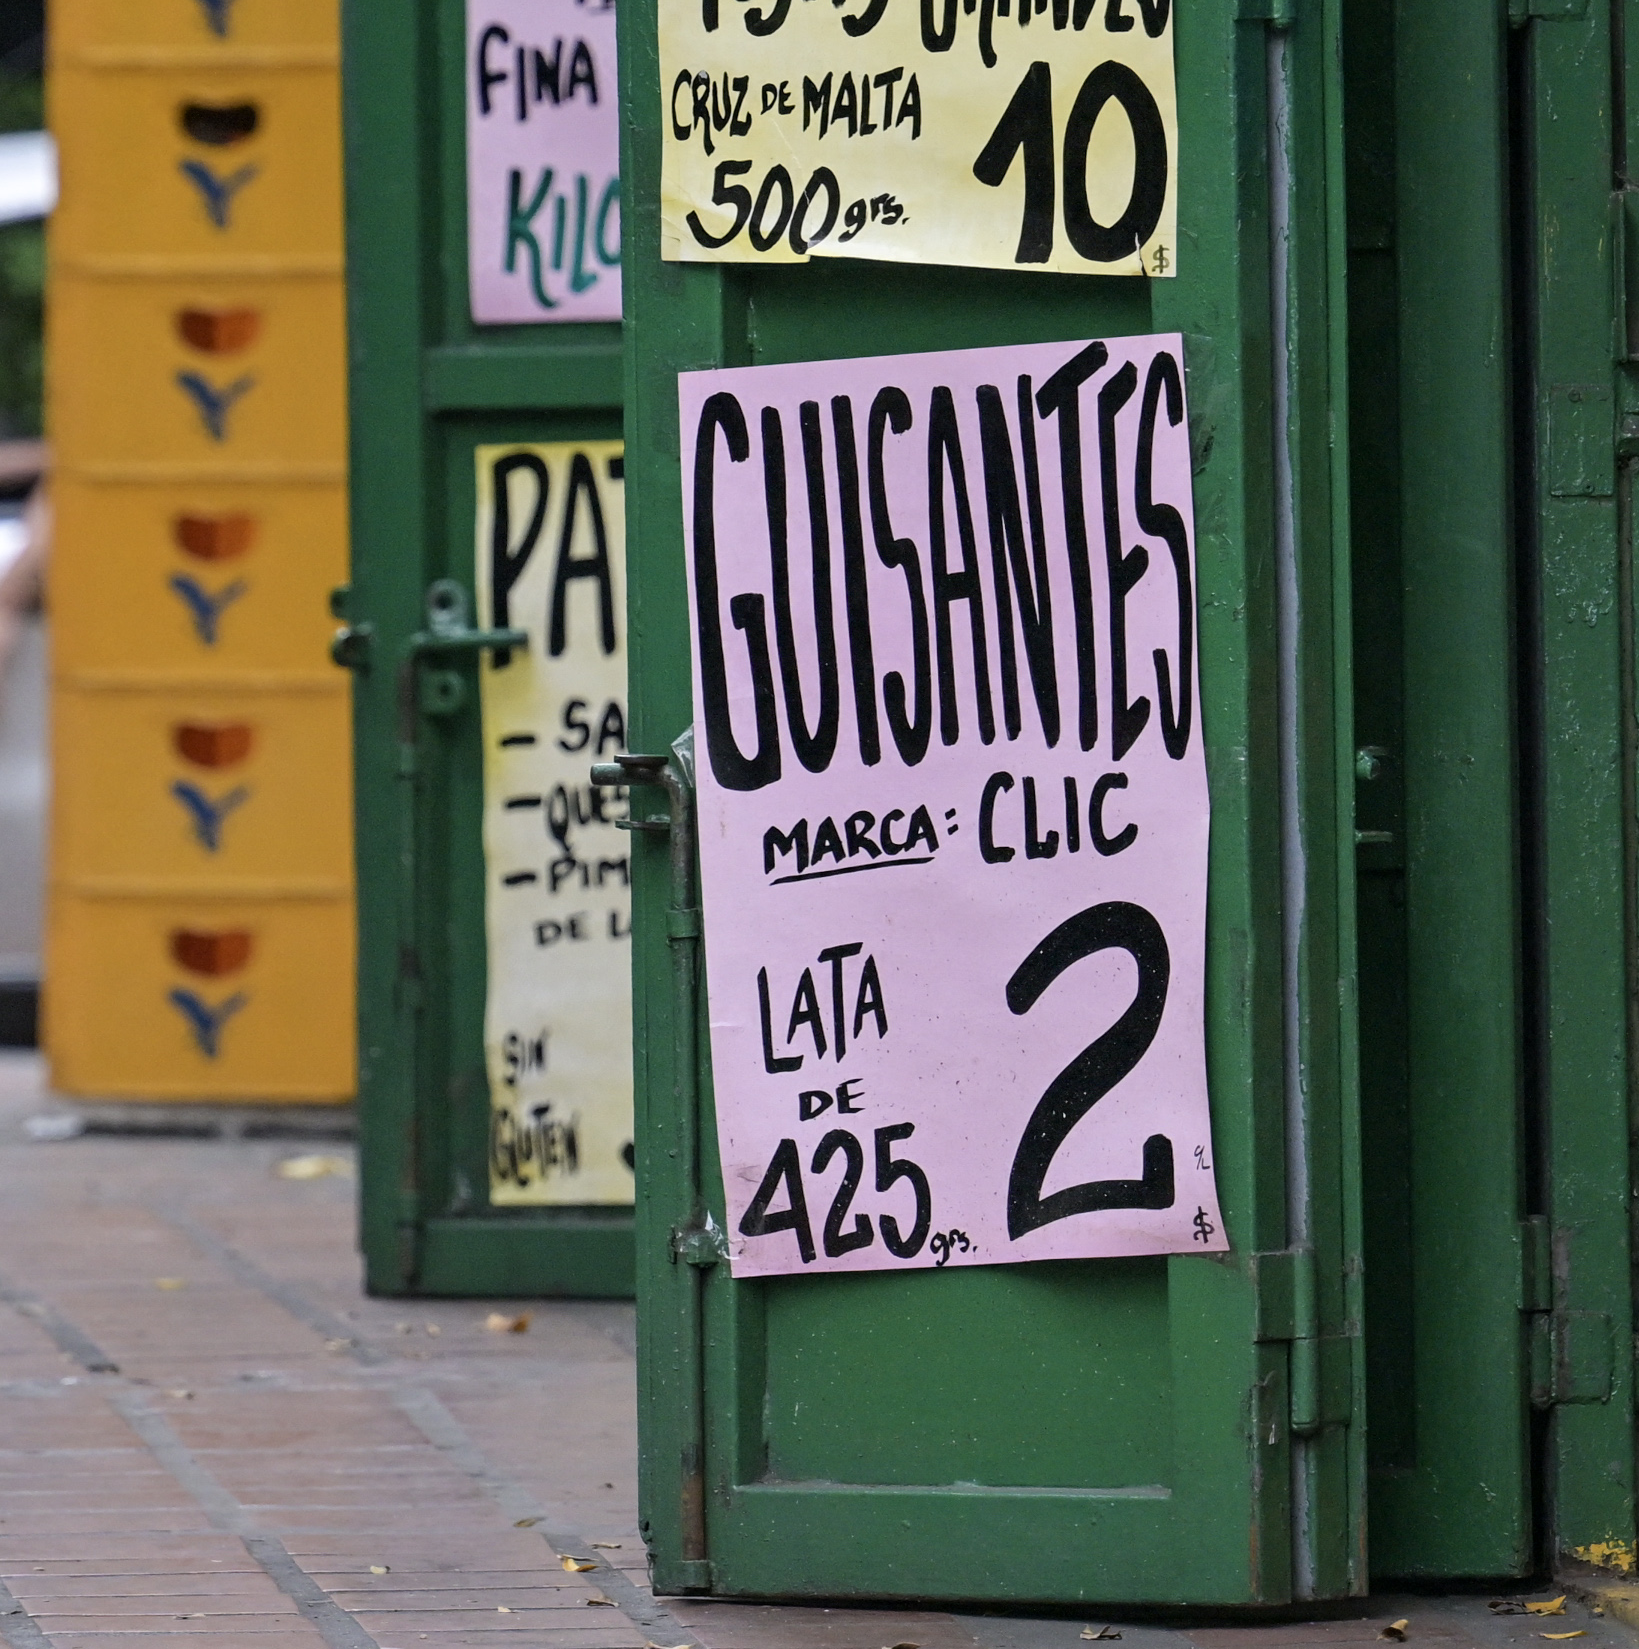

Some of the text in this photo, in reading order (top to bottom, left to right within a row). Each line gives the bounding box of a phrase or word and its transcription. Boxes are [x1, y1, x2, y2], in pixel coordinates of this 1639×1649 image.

[478, 23, 600, 121] FINA
[671, 66, 922, 151] CRUZ DE MALTA
[973, 59, 1168, 264] 10
[1152, 244, 1170, 273] $
[490, 453, 624, 670] PA
[693, 341, 1193, 791] GUISANTES
[763, 771, 1138, 876] MARCA: CLIC
[757, 942, 889, 1074] LATA
[799, 1078, 865, 1121] DE
[1005, 901, 1174, 1241] 2
[1193, 1206, 1214, 1243] $
